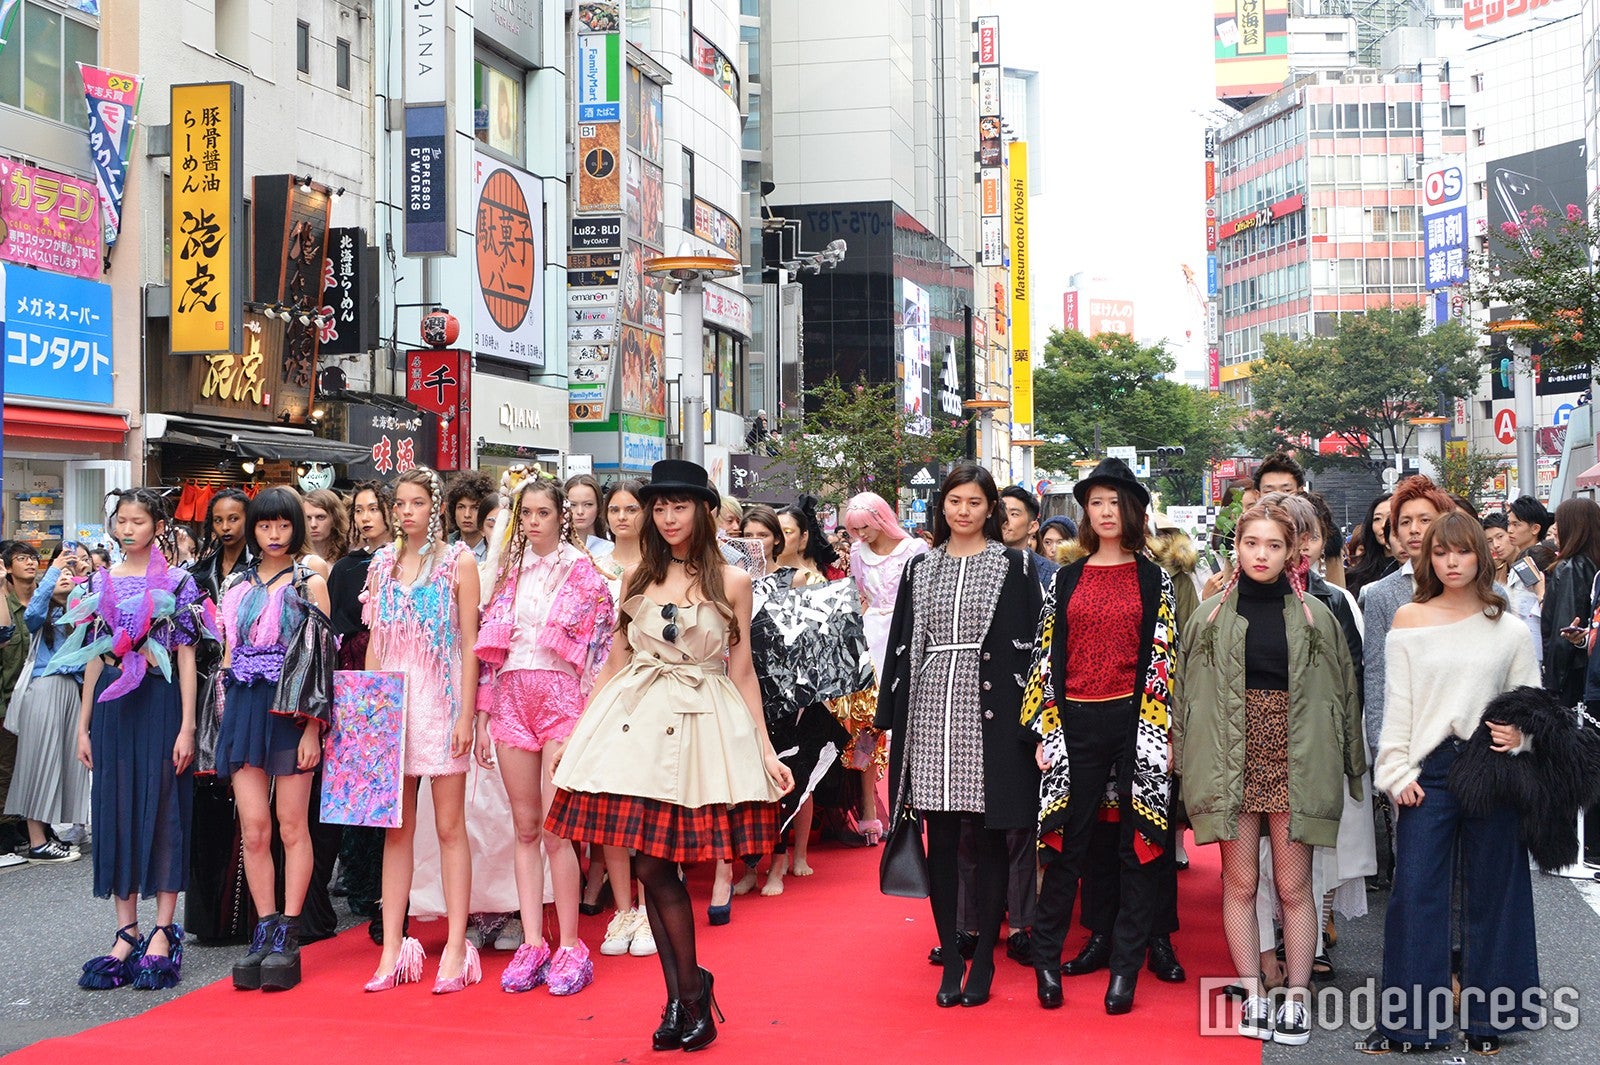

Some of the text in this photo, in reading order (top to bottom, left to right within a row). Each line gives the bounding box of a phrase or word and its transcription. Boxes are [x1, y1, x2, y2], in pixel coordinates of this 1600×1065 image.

[983, 29, 992, 60] カラオケ
[587, 48, 598, 102] FamilyMart
[584, 107, 615, 118] 酒 たばこ
[201, 106, 222, 193] 豚骨醤油
[582, 127, 594, 137] B1
[181, 109, 200, 194] らーめん
[10, 168, 96, 223] カラコン
[410, 147, 421, 211] D'WORKS
[421, 147, 431, 211] ESPRESSO
[1426, 167, 1463, 207] OS
[478, 206, 533, 267] 駄菓子
[1013, 179, 1025, 301] Matsumoto KiYoshi
[1207, 226, 1215, 246] ガスト
[1428, 212, 1463, 250] 調剤
[339, 234, 355, 323] 北海道らーめん
[488, 259, 526, 294] バー
[1428, 249, 1465, 284] 薬局
[17, 296, 100, 325] メガネスーパー
[571, 292, 608, 302] emanon
[1090, 303, 1133, 318] ほけんの
[7, 330, 109, 376] コンタクト
[1014, 349, 1029, 362] 薬
[410, 355, 422, 391] 居酒屋
[423, 364, 457, 406] 千
[569, 391, 603, 400] FamilyMart
[1498, 412, 1515, 439] A
[372, 434, 416, 476] 味源
[624, 436, 663, 465] FamilyMart
[910, 477, 936, 485] adidas
